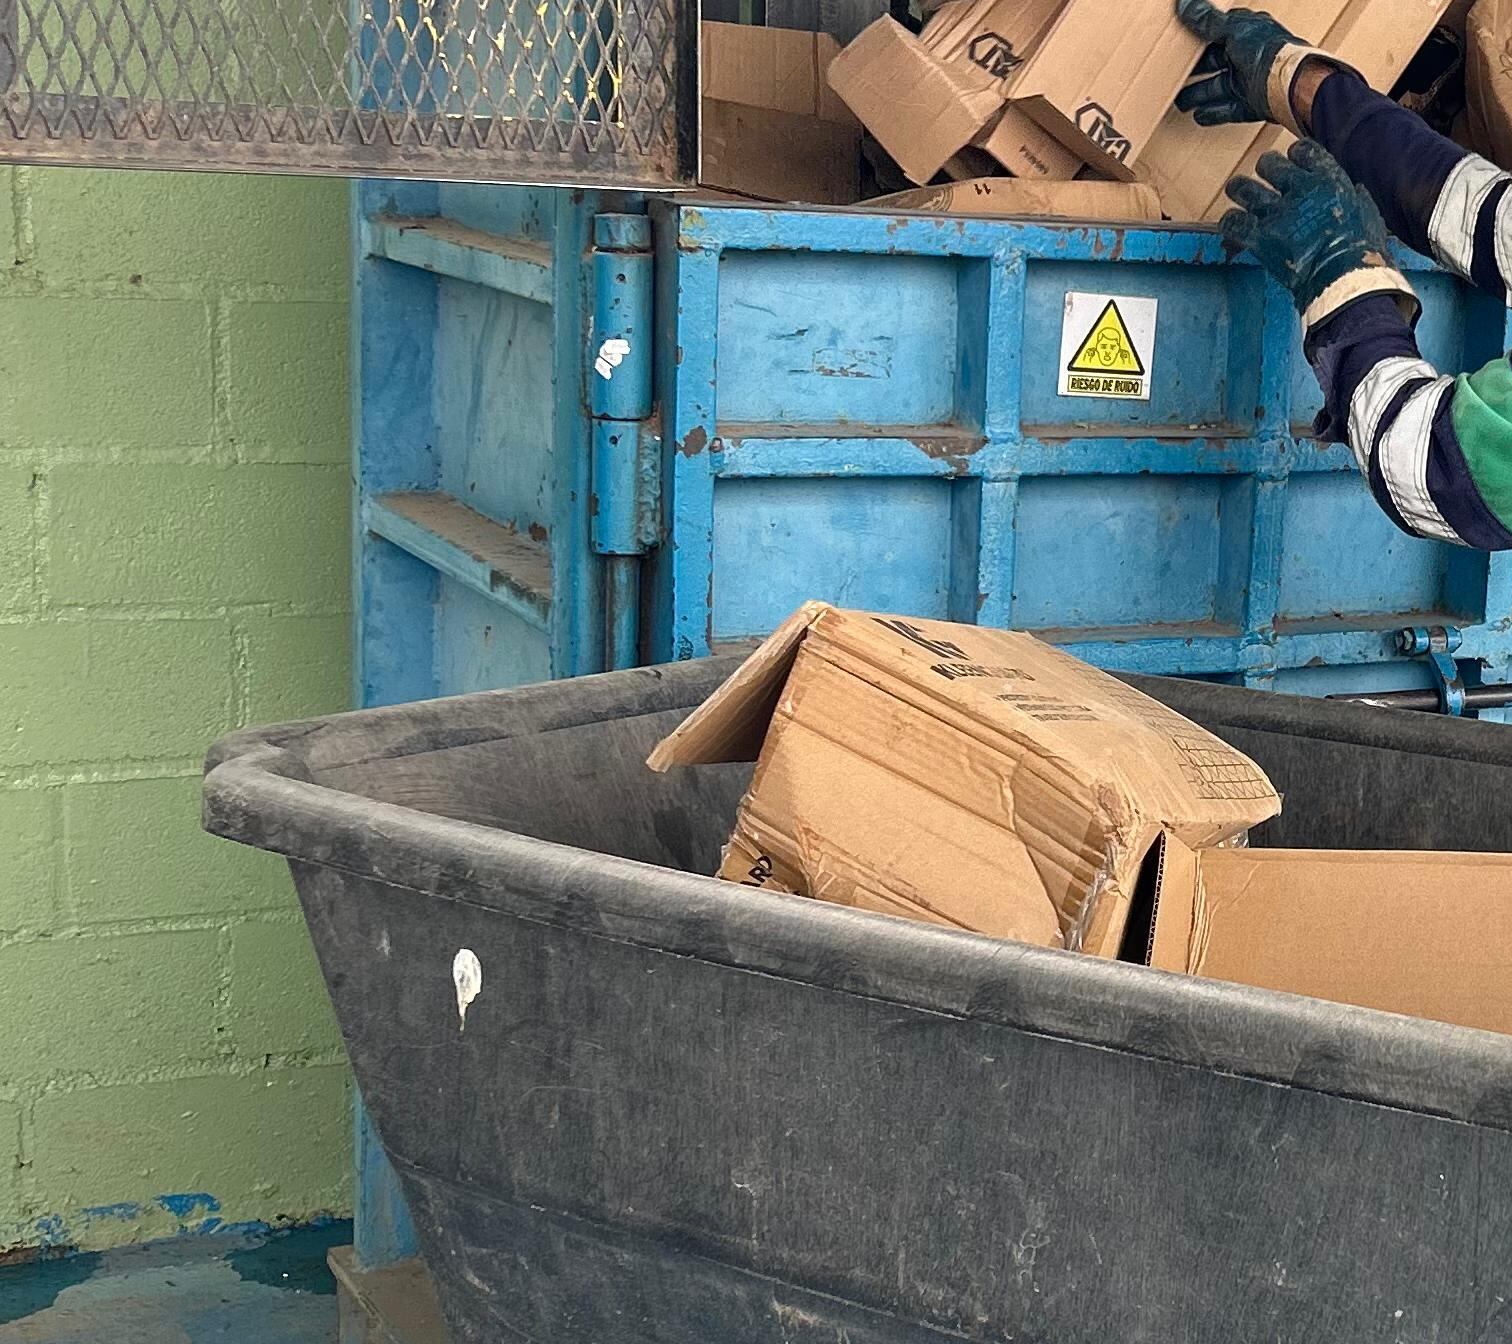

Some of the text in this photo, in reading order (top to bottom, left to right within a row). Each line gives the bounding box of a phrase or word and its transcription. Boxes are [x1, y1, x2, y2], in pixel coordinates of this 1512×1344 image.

[1070, 377, 1139, 394] RIESGO DE RUIDO
